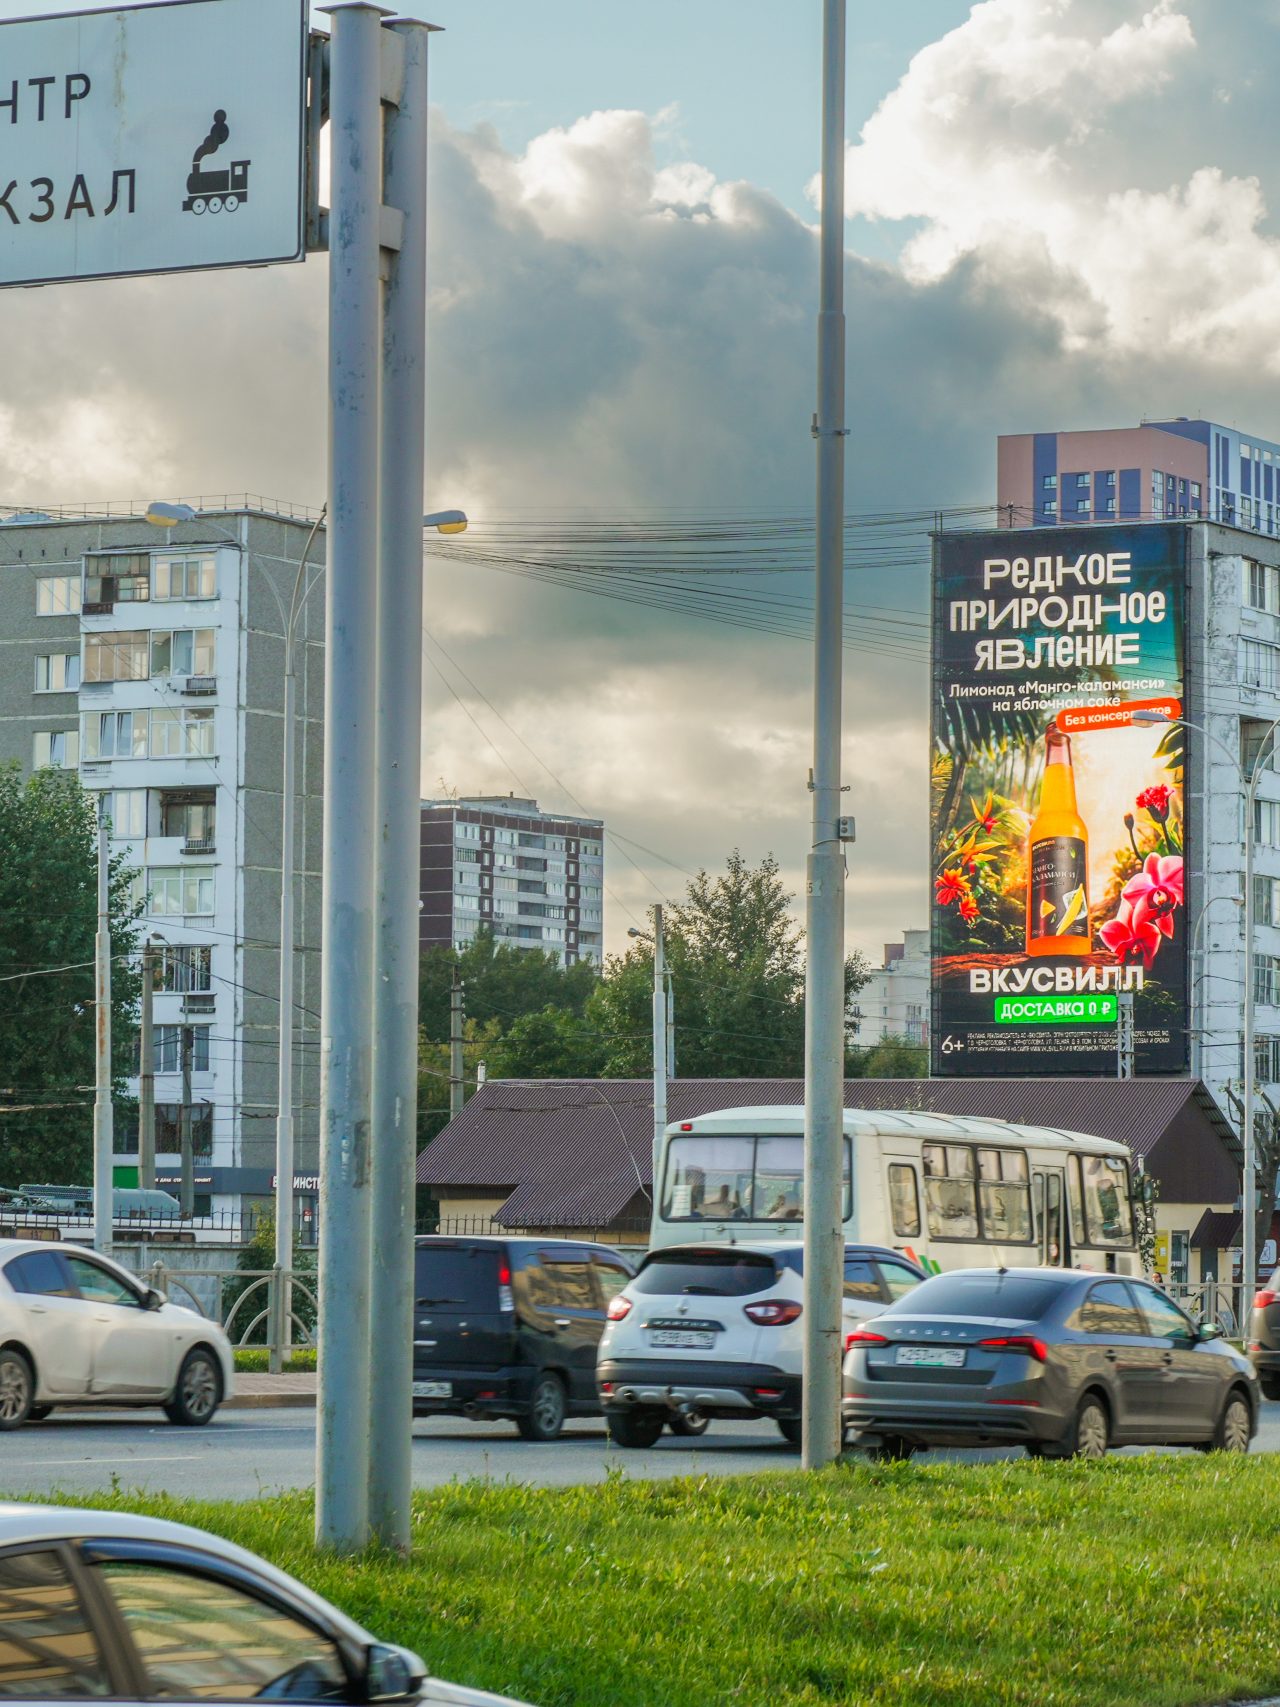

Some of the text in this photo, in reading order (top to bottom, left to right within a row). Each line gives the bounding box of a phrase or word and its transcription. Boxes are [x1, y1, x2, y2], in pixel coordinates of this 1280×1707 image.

[0, 169, 135, 224] КЗАЛ
[949, 678, 1165, 698] Лимонад «Манго-каламанси»
[992, 696, 1121, 712] на яблочном соке
[1064, 714, 1086, 726] Без
[970, 965, 1144, 993] ВКУСВИЛЛ
[1088, 1001, 1096, 1016] 0
[941, 1035, 964, 1054] 6+
